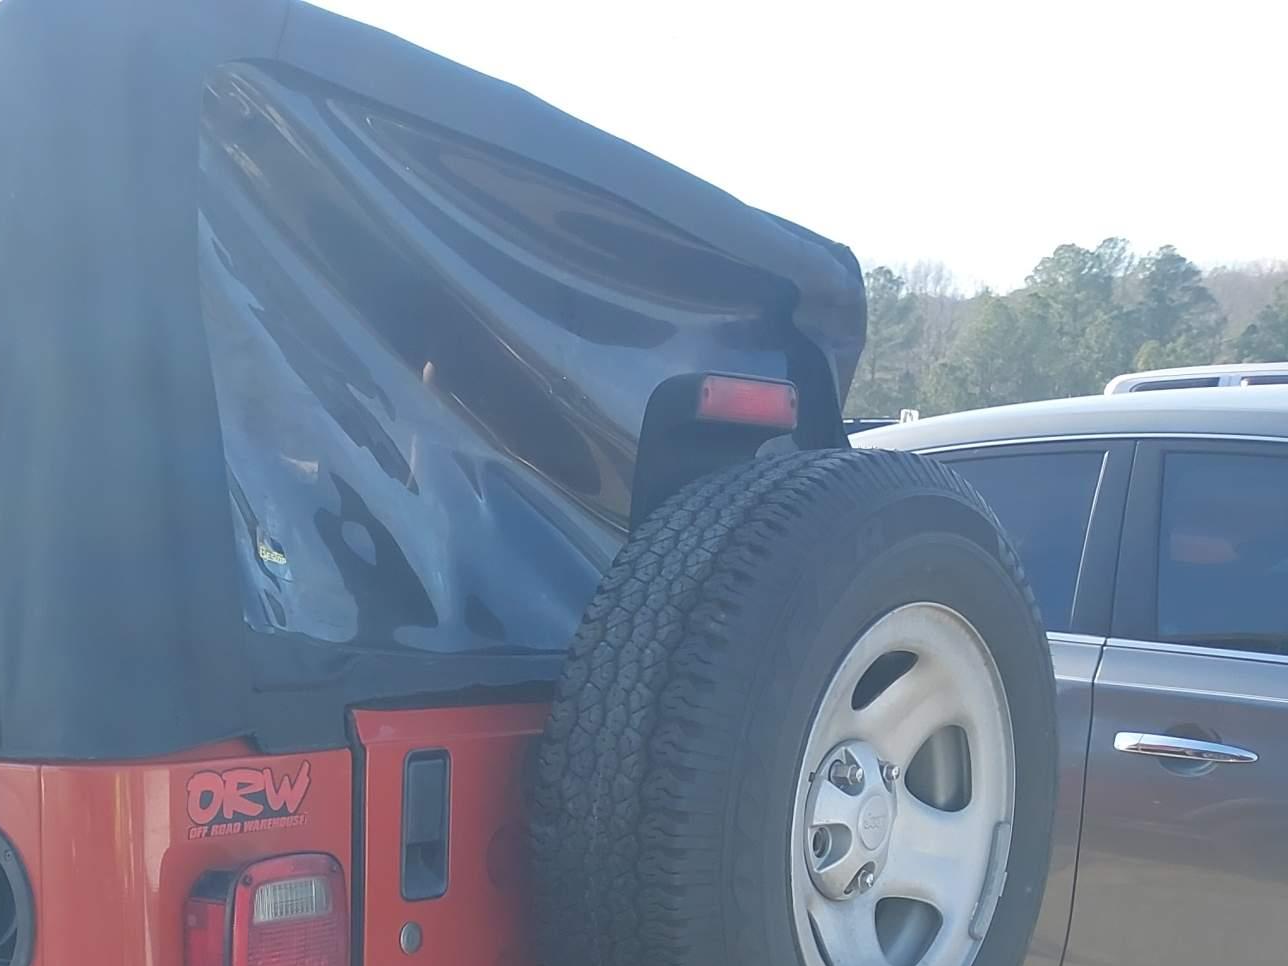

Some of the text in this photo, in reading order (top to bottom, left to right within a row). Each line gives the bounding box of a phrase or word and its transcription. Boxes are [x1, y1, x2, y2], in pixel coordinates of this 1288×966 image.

[186, 759, 311, 825] ORW
[188, 826, 210, 840] OFF
[211, 821, 241, 836] ROAD
